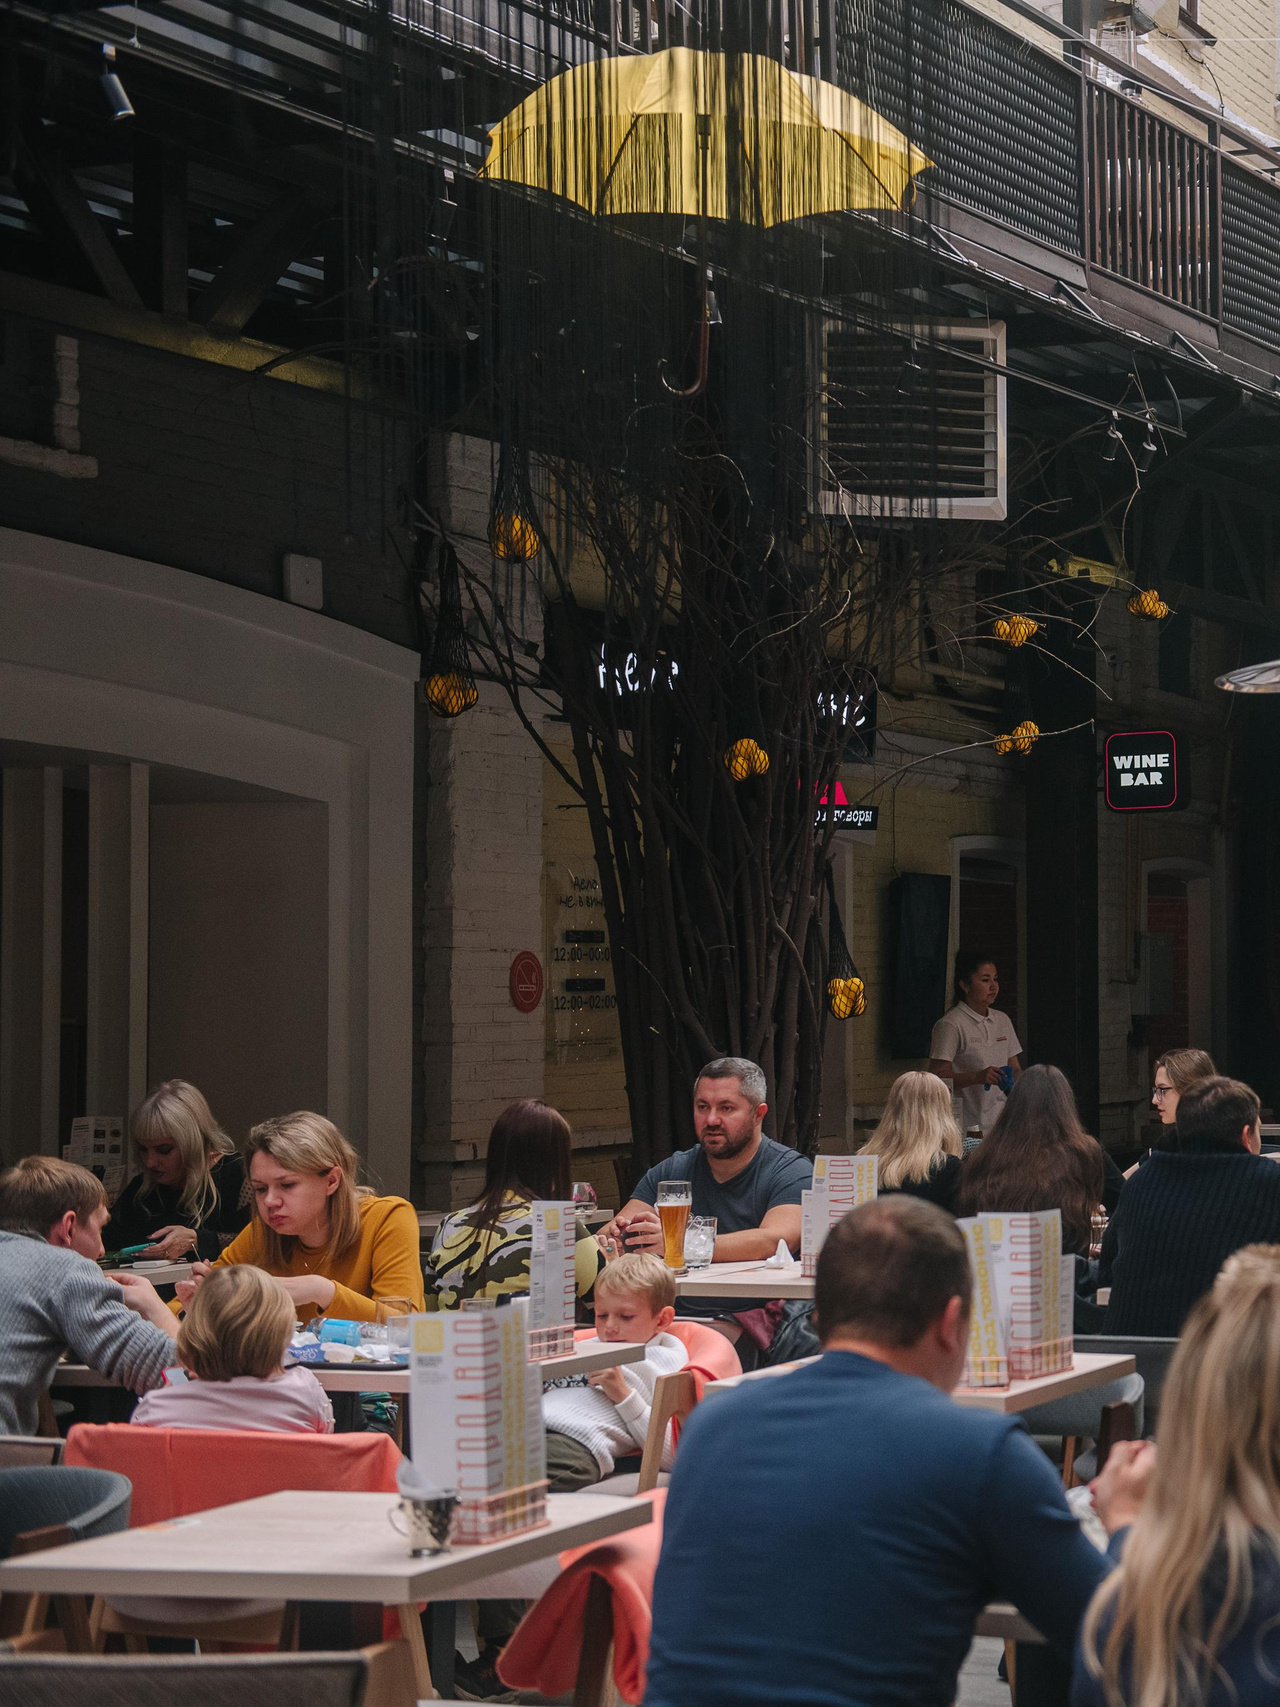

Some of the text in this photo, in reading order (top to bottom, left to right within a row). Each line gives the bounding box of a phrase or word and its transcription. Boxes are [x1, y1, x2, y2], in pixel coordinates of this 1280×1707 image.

[1113, 754, 1169, 769] WINE
[1120, 772, 1163, 786] BAR
[814, 809, 873, 827] говоры
[586, 896, 604, 908] вин
[554, 947, 610, 961] 12:00-00:0
[554, 995, 617, 1010] 12:00-02:00
